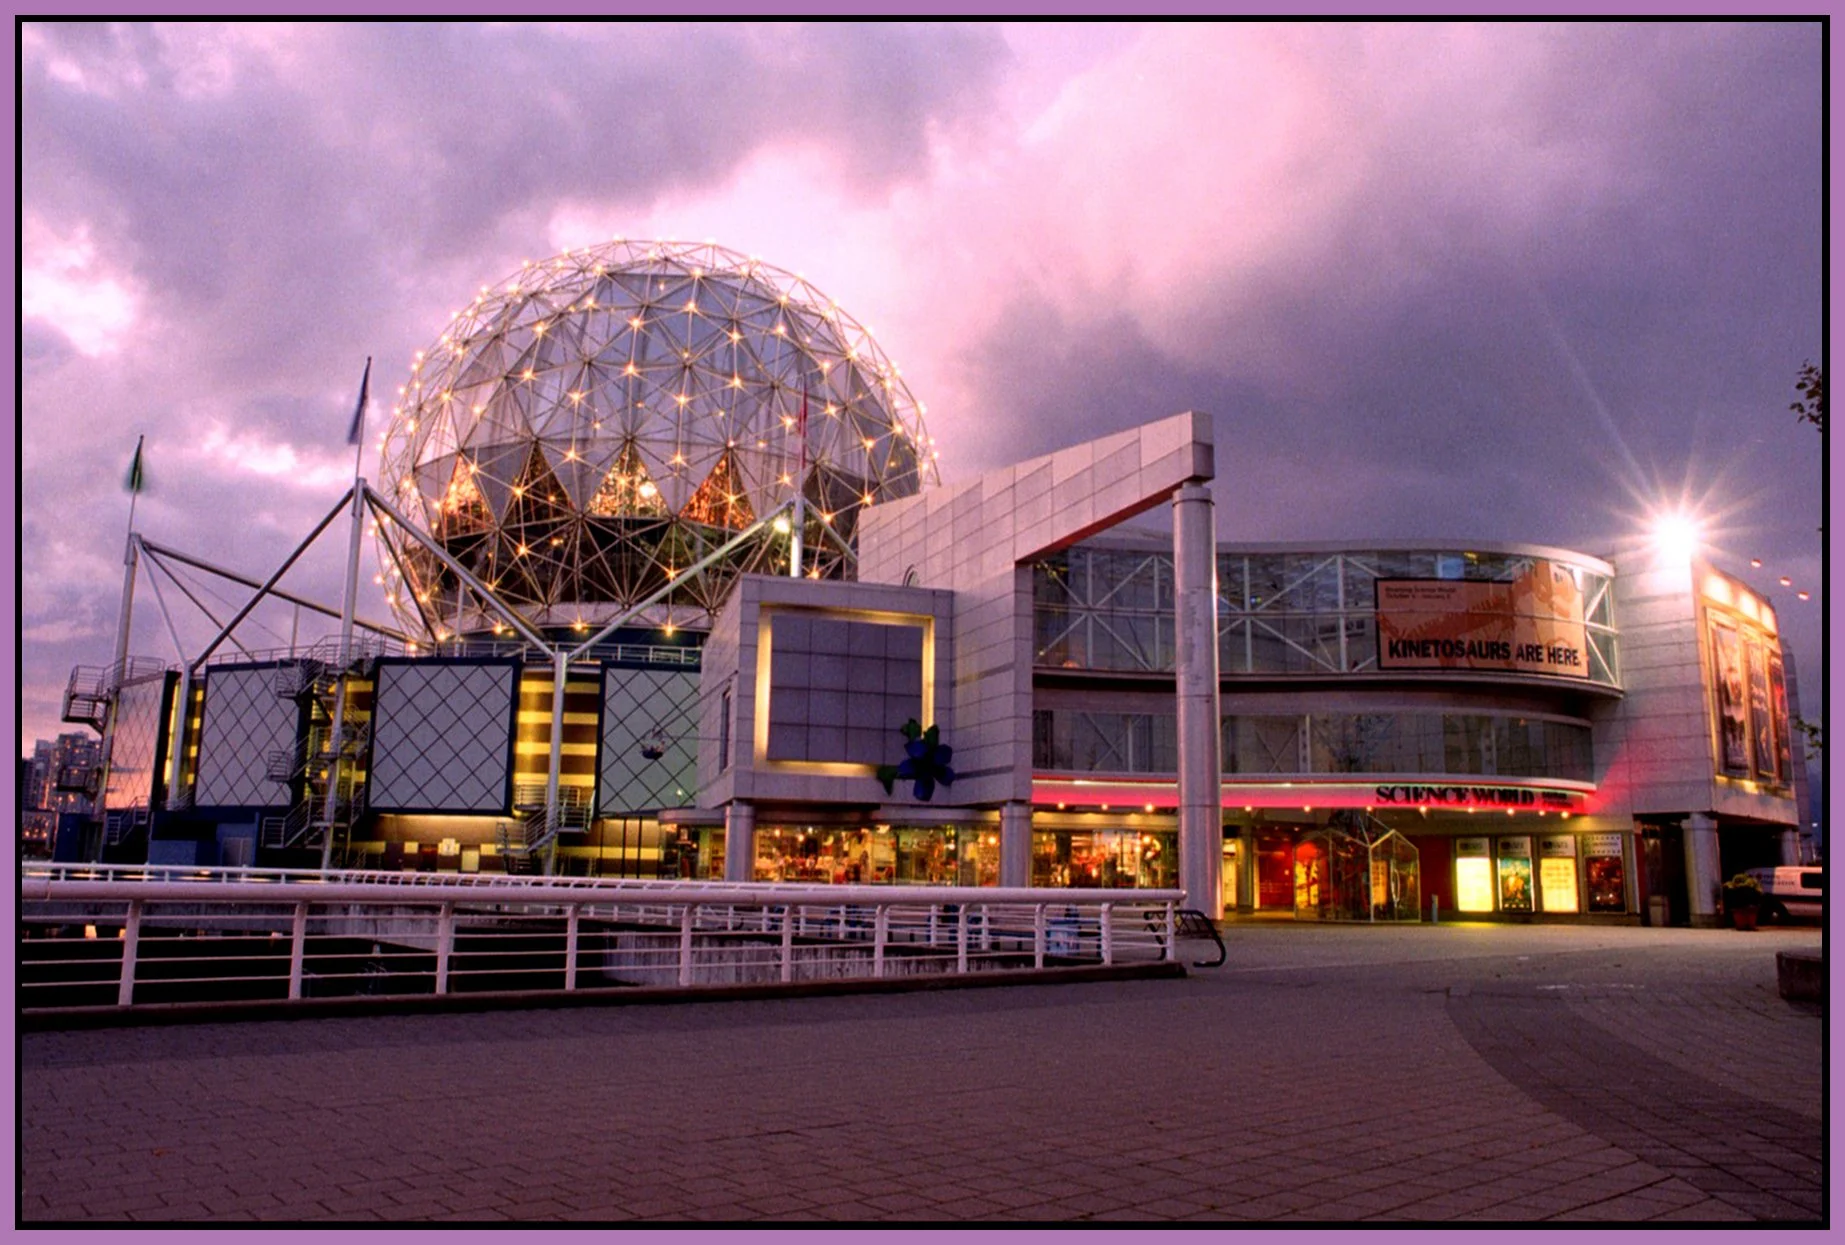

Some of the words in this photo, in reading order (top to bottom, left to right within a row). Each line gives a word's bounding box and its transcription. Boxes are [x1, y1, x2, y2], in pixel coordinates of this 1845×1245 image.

[1388, 639, 1511, 660] KINETOSAURS
[1516, 644, 1544, 662] ARE
[1547, 645, 1581, 667] HERE.
[1376, 786, 1470, 805] SCIENCE
[1472, 788, 1535, 805] WORLD
